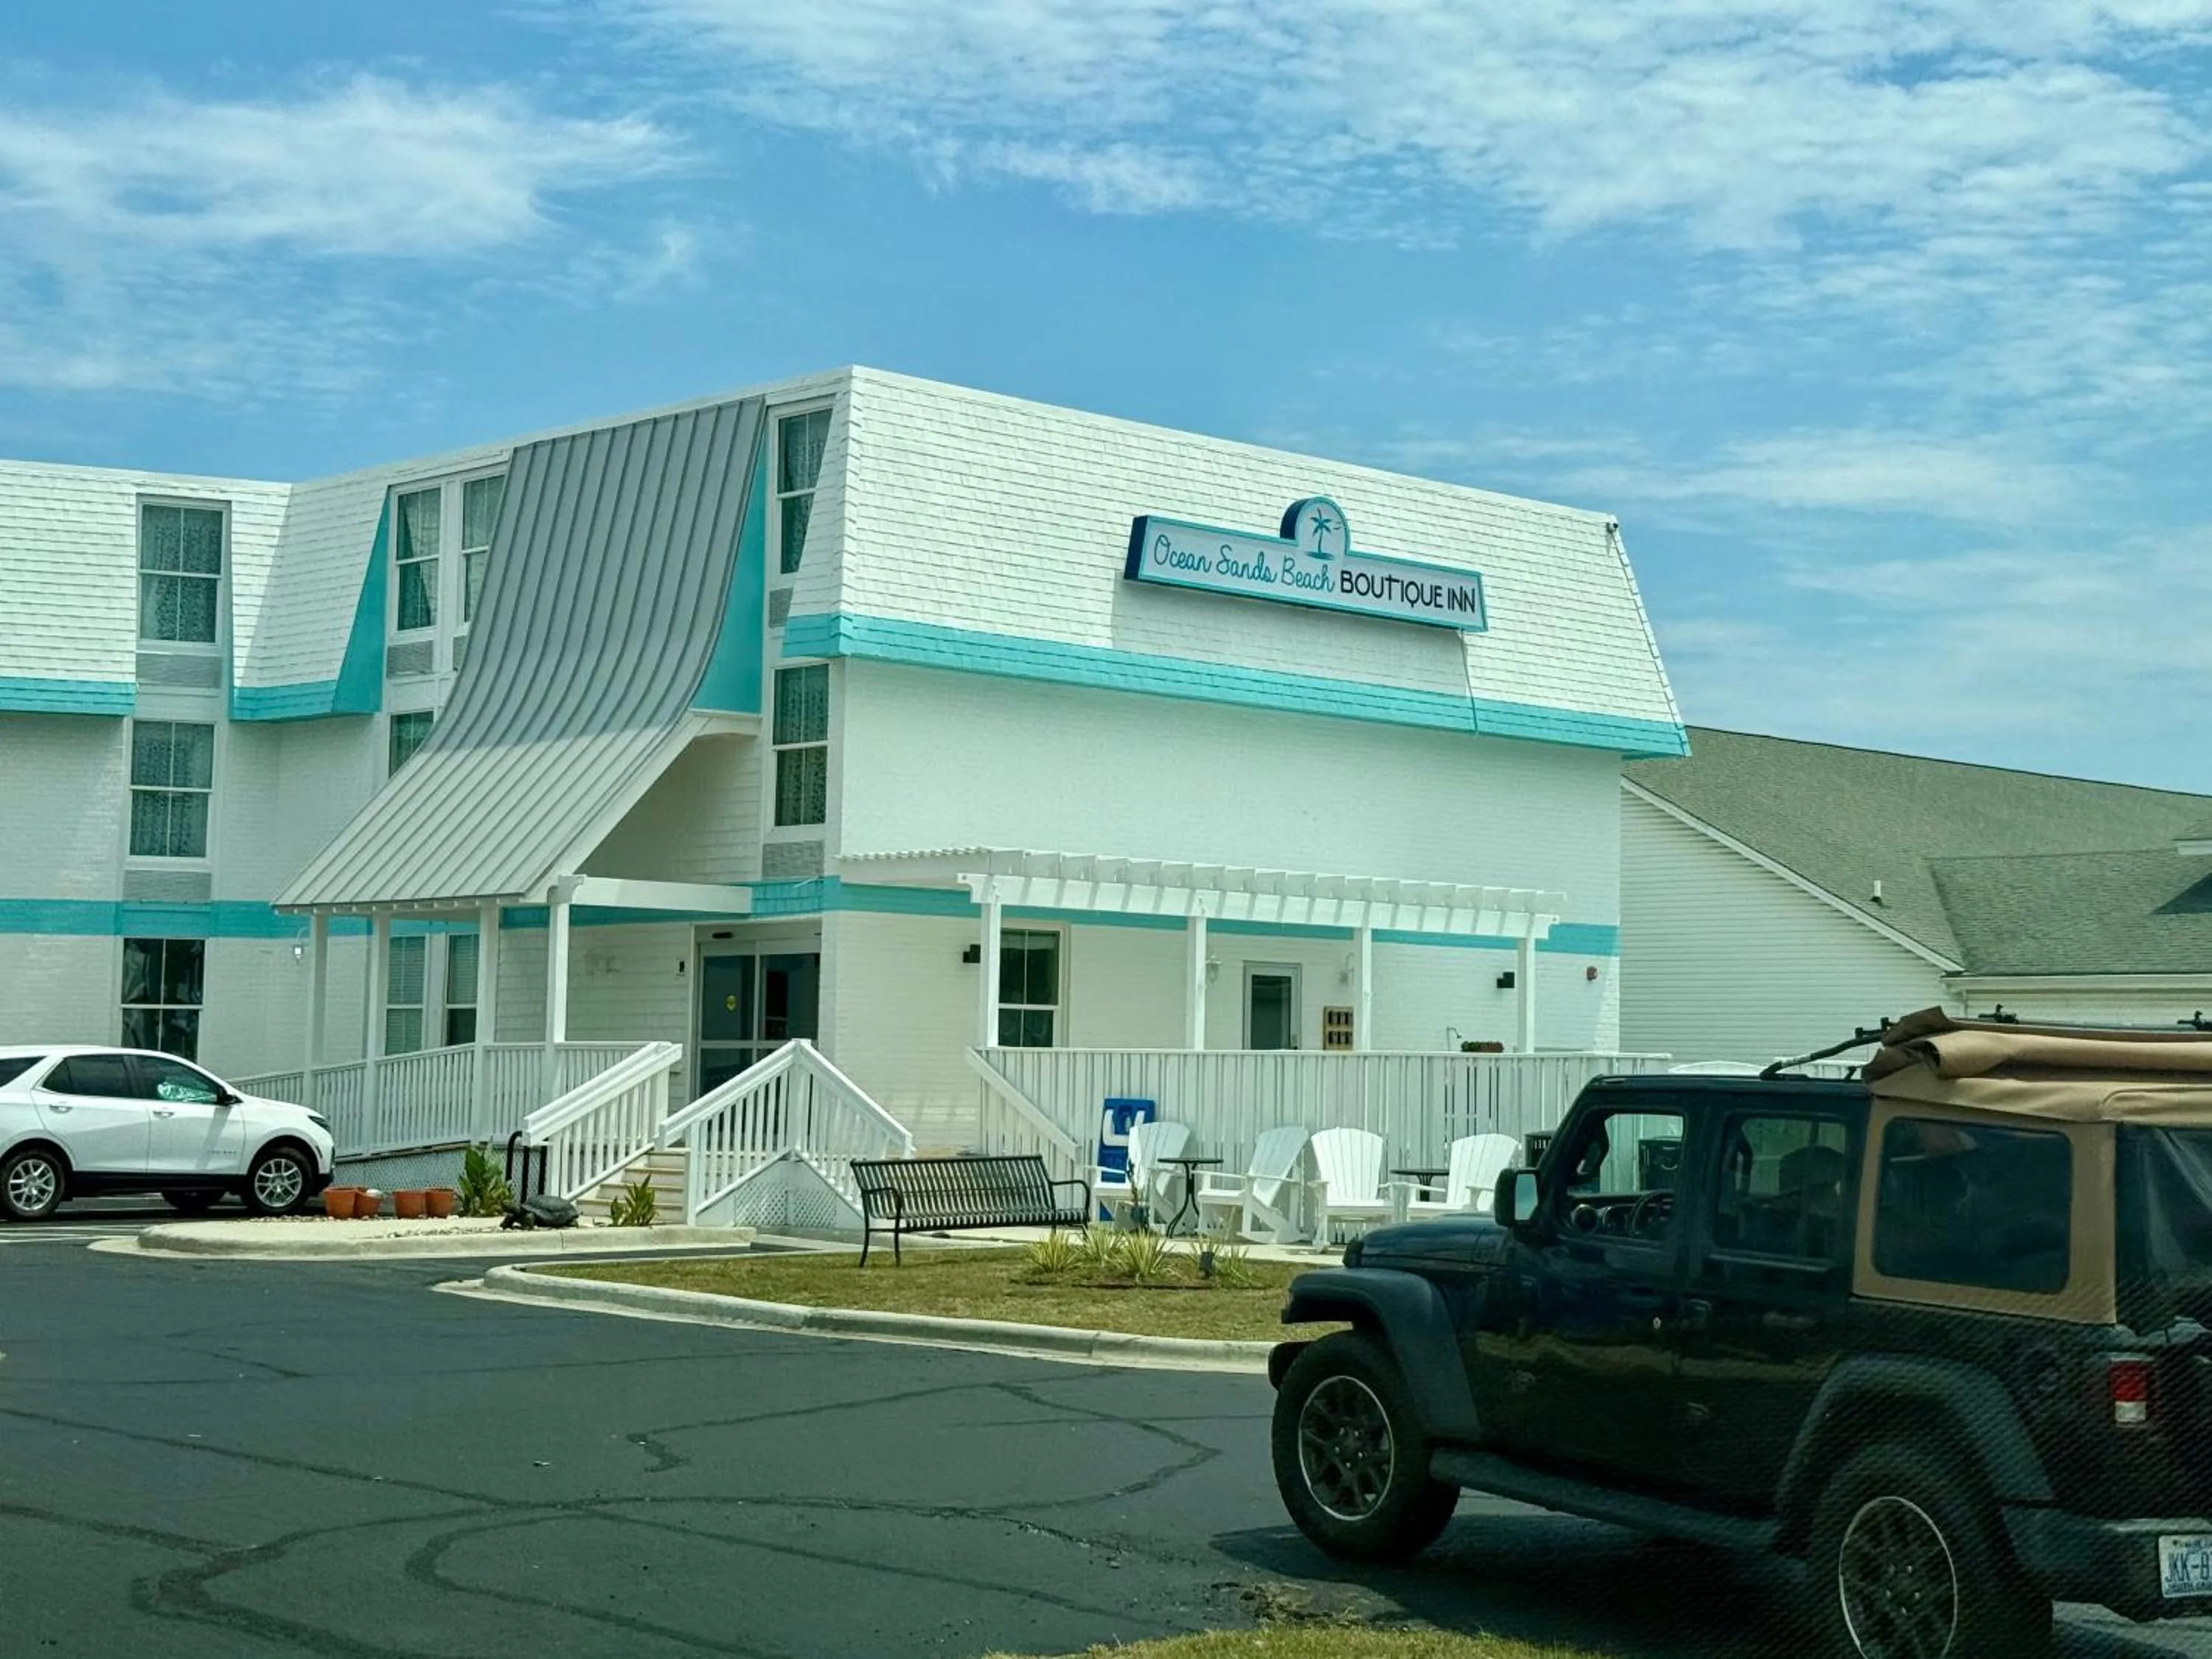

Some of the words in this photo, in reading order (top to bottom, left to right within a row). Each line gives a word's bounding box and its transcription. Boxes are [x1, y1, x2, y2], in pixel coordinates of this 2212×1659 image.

[1153, 534, 1212, 573] Ocean
[1216, 544, 1278, 584] Sands
[1280, 554, 1335, 593] Beach
[1340, 570, 1444, 609] BOUTIQUE
[1447, 585, 1476, 614] INN
